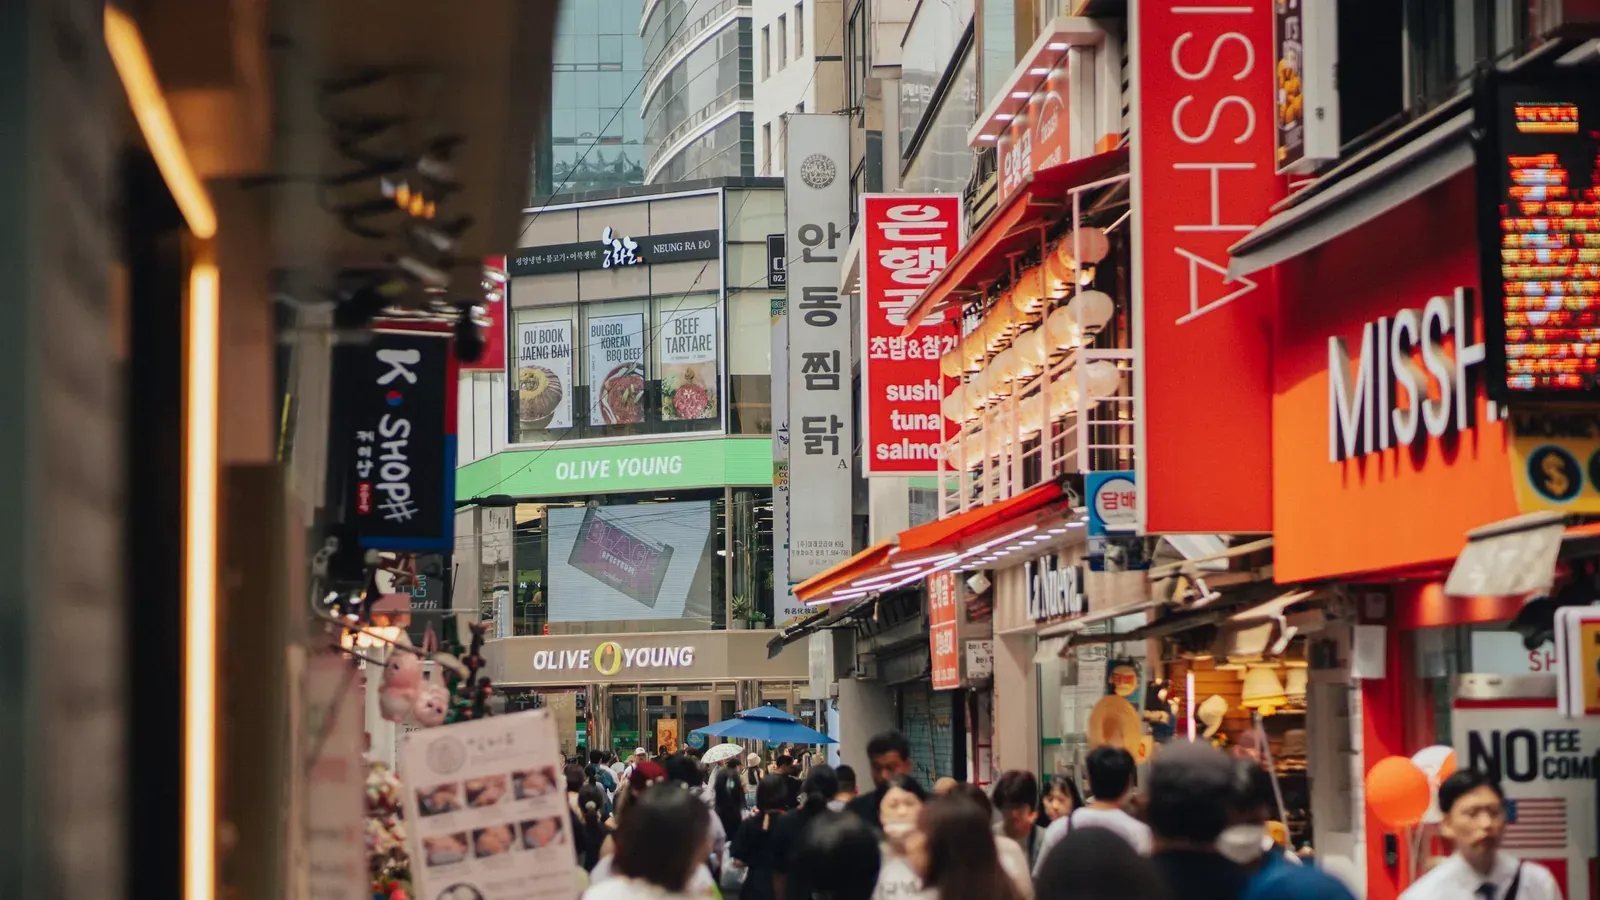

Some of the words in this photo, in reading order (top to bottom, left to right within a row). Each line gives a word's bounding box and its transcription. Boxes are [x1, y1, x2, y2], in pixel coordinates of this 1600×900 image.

[653, 242, 683, 254] NEUNG
[684, 241, 696, 251] RA
[698, 239, 711, 249] DO
[591, 323, 623, 338] BULGOGI
[674, 317, 700, 336] BEEF
[524, 330, 537, 345] OU
[539, 328, 564, 344] BOOK
[600, 335, 631, 350] KOREAN
[665, 334, 712, 354] TARTARE
[520, 344, 549, 361] JAENG
[551, 343, 570, 359] BAN
[606, 348, 622, 362] BBQ
[623, 347, 642, 361] BEEF
[555, 459, 611, 481] OLIVE
[616, 455, 683, 477] YOUNG
[533, 649, 591, 671] OLIVE
[624, 646, 696, 668] YOUNG
[1468, 728, 1538, 783] NO
[1543, 729, 1581, 752] FEE
